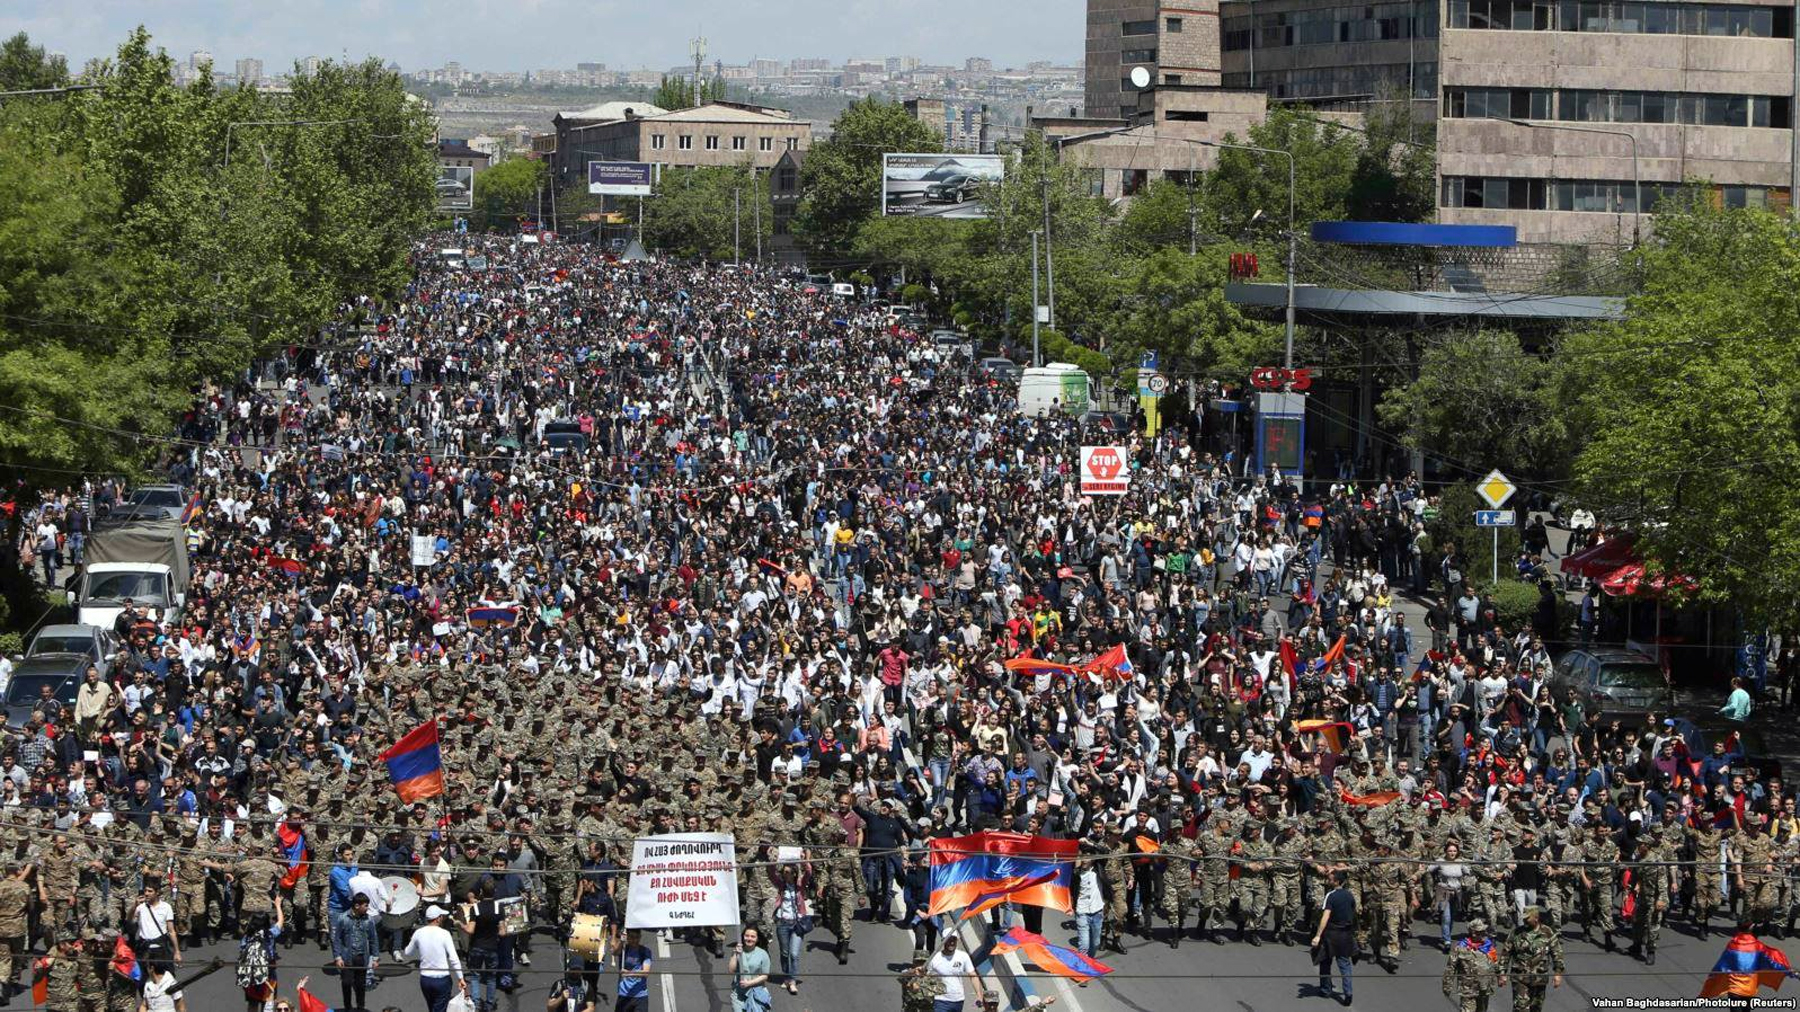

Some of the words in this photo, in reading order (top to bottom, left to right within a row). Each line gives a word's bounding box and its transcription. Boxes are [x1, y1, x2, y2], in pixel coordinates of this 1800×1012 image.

[1143, 351, 1155, 367] P
[1151, 379, 1163, 388] 70
[1091, 454, 1118, 466] STOP
[650, 877, 661, 889] ՔՈ
[662, 875, 717, 888] ՀԱՎԱՔԱԿԱՆ
[657, 891, 680, 903] ՈՒԺԻ
[681, 890, 700, 903] ՄԵՋ
[701, 890, 708, 902] Է
